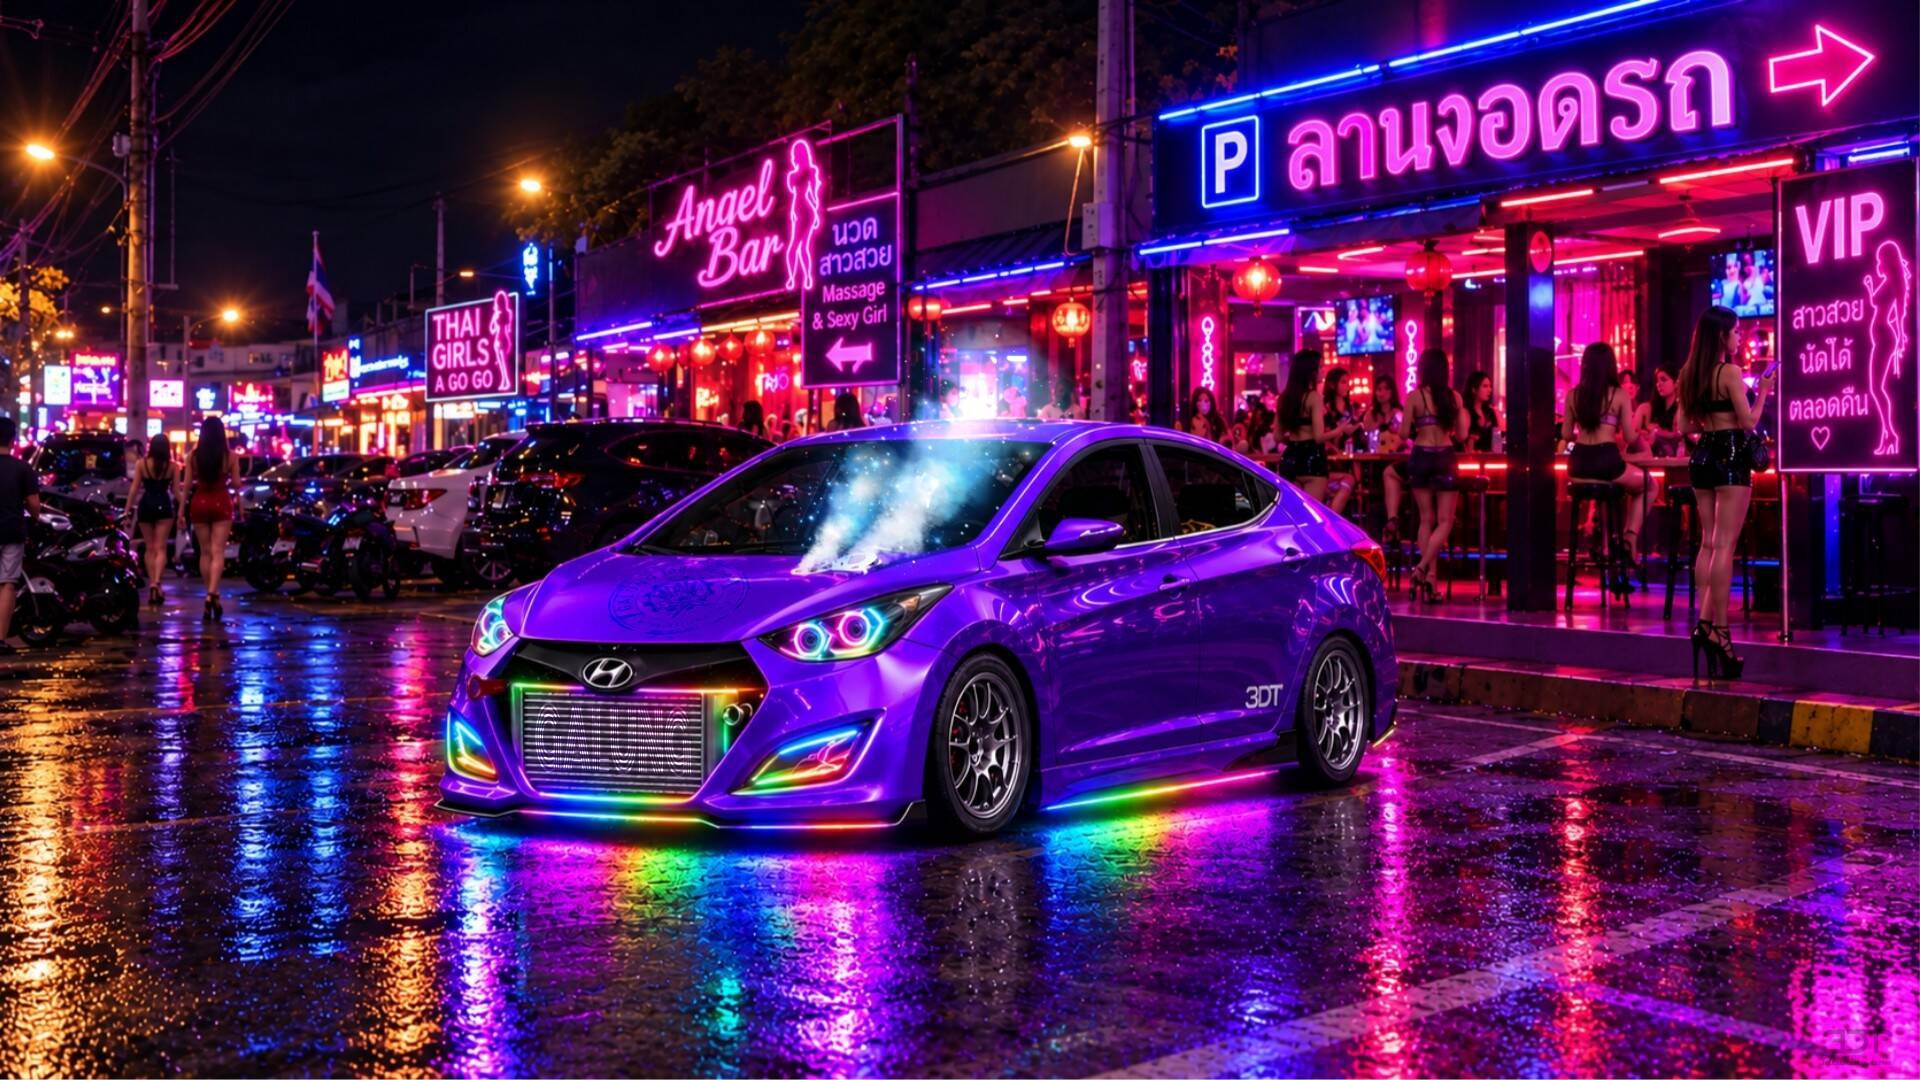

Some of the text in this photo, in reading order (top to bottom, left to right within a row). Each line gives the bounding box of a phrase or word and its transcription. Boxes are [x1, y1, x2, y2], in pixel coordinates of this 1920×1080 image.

[1215, 131, 1247, 194] P
[832, 216, 878, 246] นวด
[1795, 191, 1884, 264] VIP
[697, 226, 784, 288] Bar
[819, 244, 892, 276] สาวสวย
[823, 281, 885, 303] Massage
[432, 307, 481, 341] THAI
[812, 303, 887, 331] & Sexy Girl
[1792, 298, 1864, 329] สาวสวย
[432, 338, 490, 370] GIRLS
[1799, 336, 1854, 374] นัดได้
[434, 369, 493, 392] A GO GO
[1245, 683, 1284, 709] 3DT
